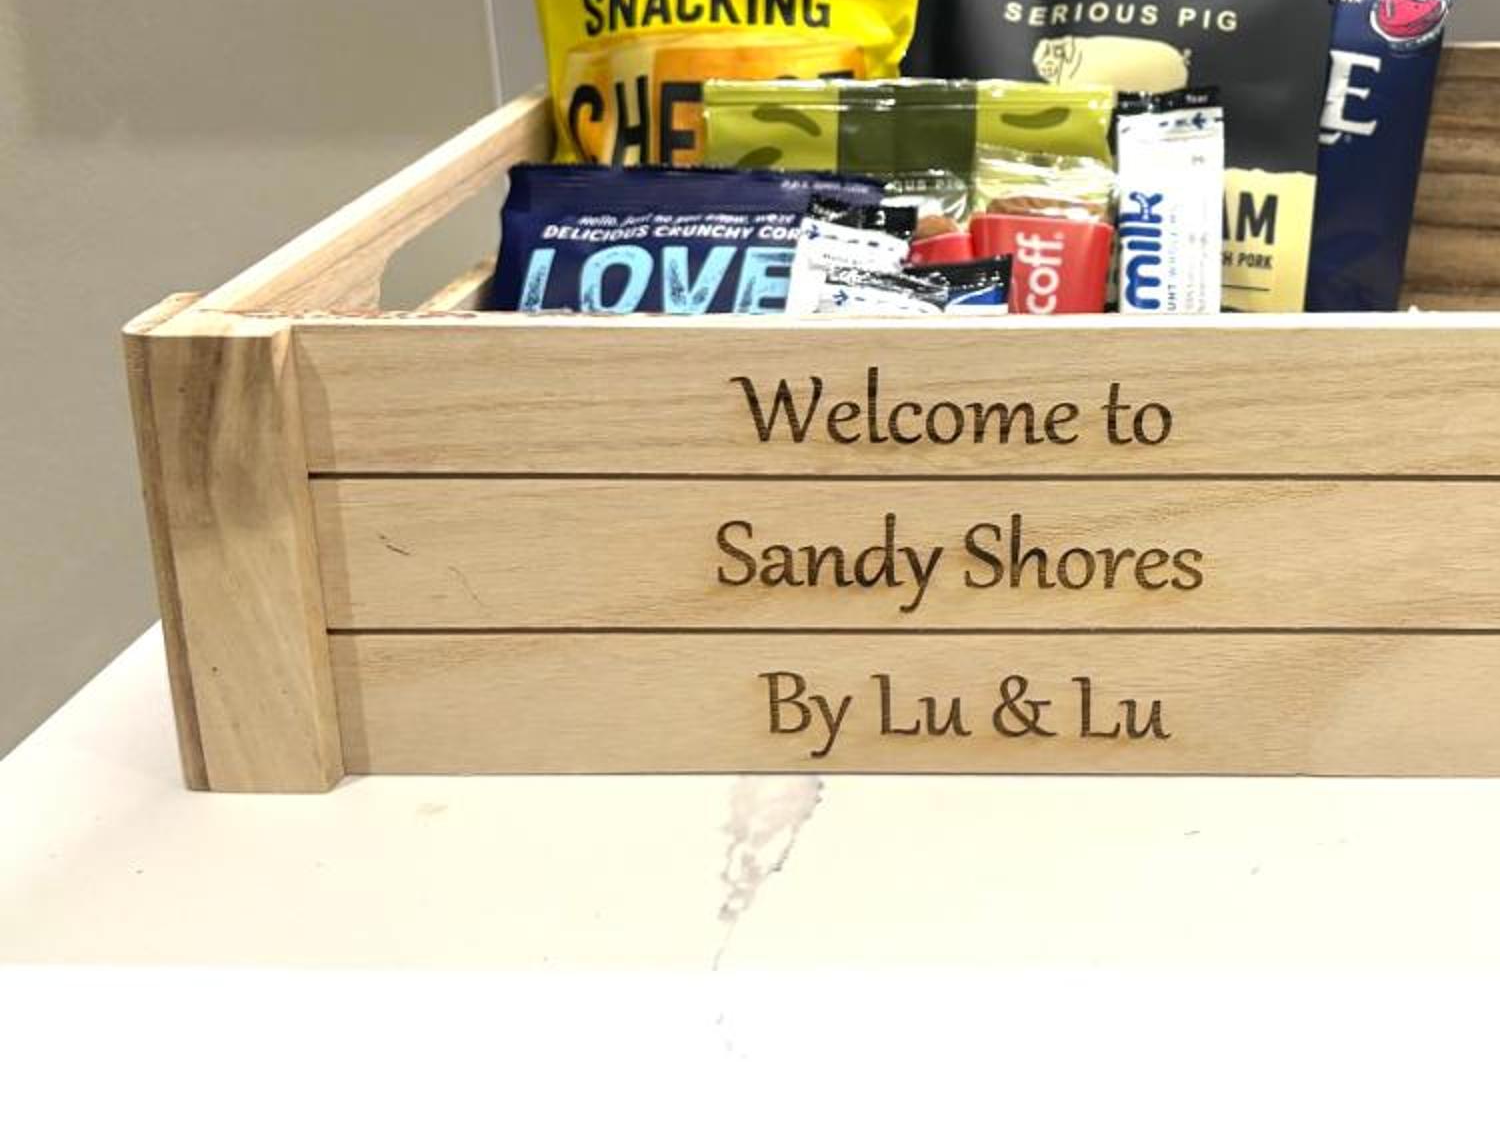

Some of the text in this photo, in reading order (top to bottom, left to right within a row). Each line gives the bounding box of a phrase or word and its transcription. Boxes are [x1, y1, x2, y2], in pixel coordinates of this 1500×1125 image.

[1003, 1, 1239, 32] SERIOUS PIG
[542, 224, 801, 242] DELICIOUS CRUNCHY COR
[1117, 191, 1164, 310] milk
[1237, 252, 1273, 269] PORK
[731, 366, 1173, 446] Welcome to
[716, 512, 1204, 614] Sandy Shores
[757, 671, 1172, 759] By Lu & Lu
